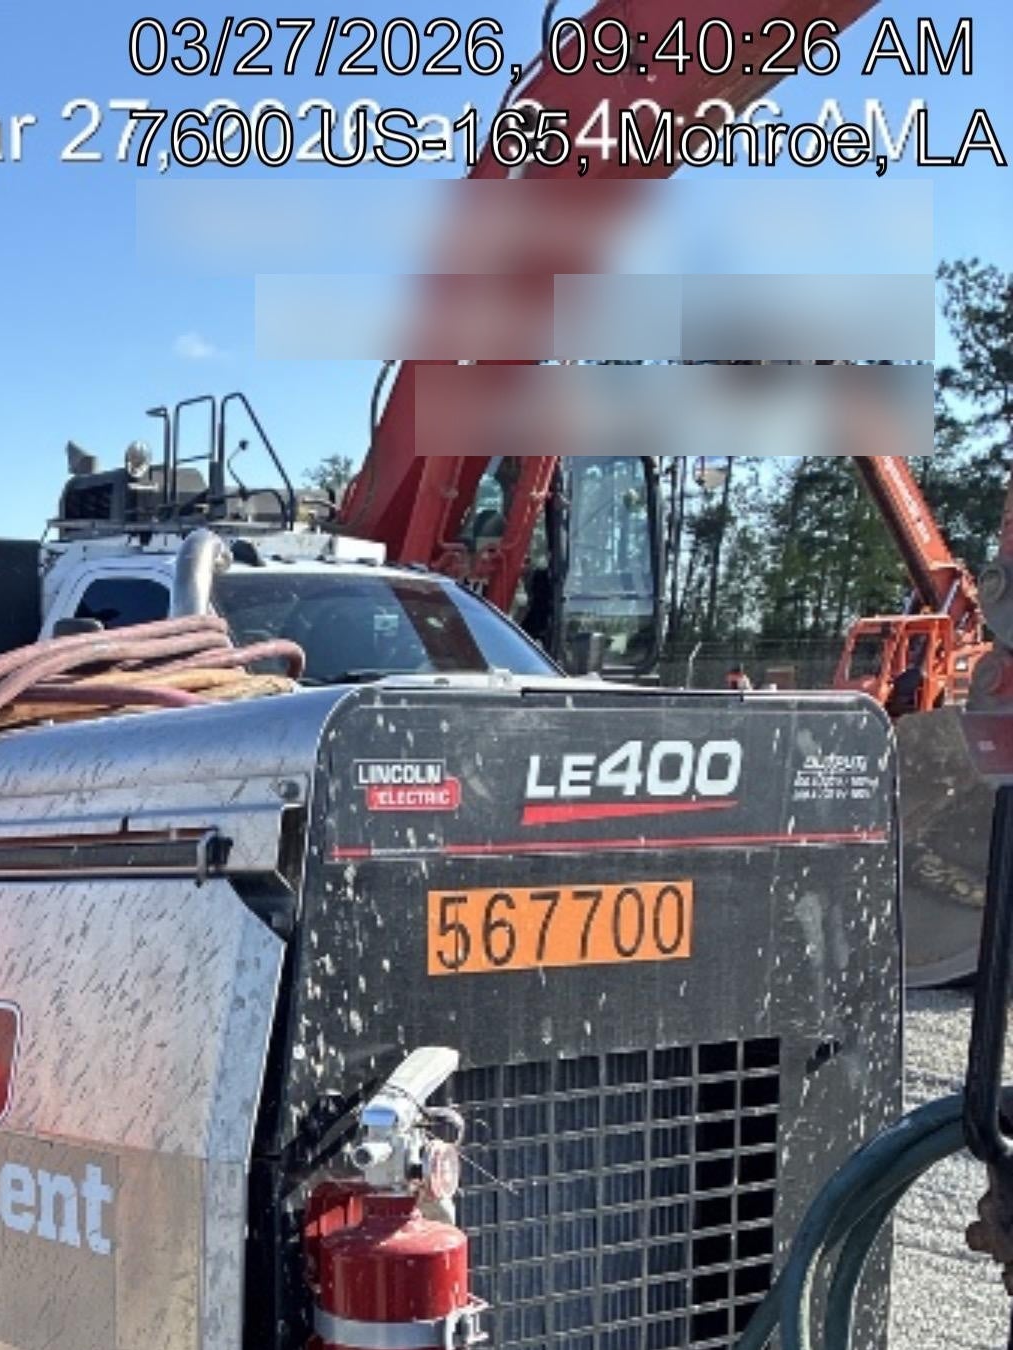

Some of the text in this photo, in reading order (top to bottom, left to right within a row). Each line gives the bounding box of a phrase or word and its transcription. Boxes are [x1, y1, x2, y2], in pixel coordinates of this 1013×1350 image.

[358, 763, 442, 786] LINCOLN
[526, 739, 743, 799] LE400
[377, 788, 451, 807] ELECTRIC
[436, 884, 685, 970] 567700
